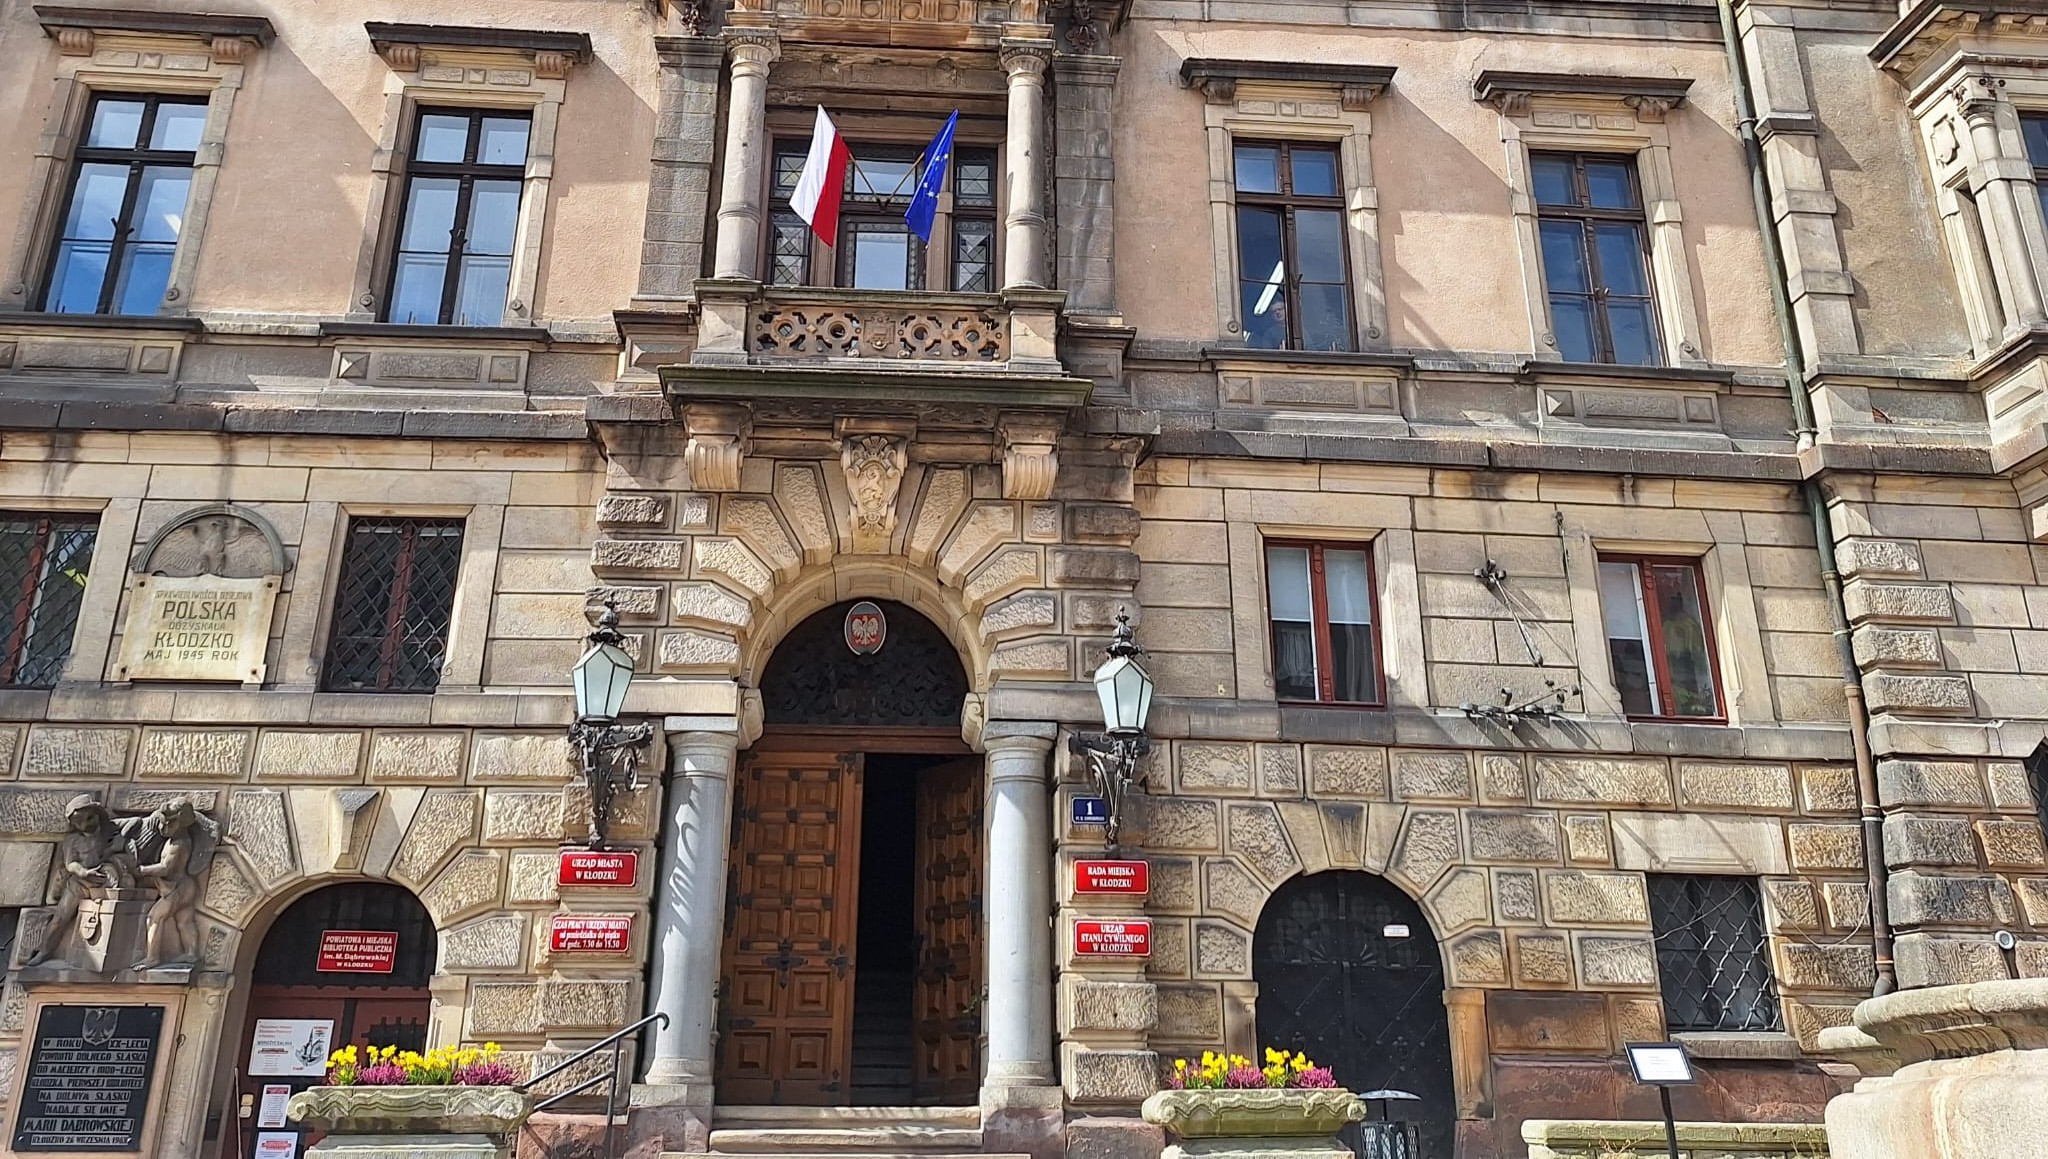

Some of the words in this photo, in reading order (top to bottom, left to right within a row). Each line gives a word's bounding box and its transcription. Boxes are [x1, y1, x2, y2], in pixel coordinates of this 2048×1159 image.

[162, 601, 236, 620] POLSKA
[154, 632, 234, 648] KŁODZKO
[144, 650, 171, 660] MAJ
[178, 650, 204, 660] 1945
[211, 650, 239, 661] ROK
[1086, 800, 1094, 816] 1
[571, 859, 597, 869] URZĄD
[597, 859, 623, 868] MIASTA
[575, 871, 583, 880] W
[583, 871, 618, 880] KŁODZKU
[1087, 866, 1107, 876] RADA
[1107, 867, 1136, 877] MIEJSKA
[1091, 878, 1099, 887] W
[1099, 878, 1133, 888] KŁODZKU
[1100, 924, 1125, 935] URZĄD
[325, 935, 362, 944] POWIATOWA
[366, 936, 393, 945] MIEJSKA
[1080, 933, 1103, 943] STANU
[1103, 934, 1145, 944] CYWILNEGO
[322, 944, 358, 952] BIBLIOTEKA
[358, 944, 393, 953] PUBLICZNA
[1092, 943, 1100, 952] W
[1100, 943, 1134, 953] KŁODZKU
[25, 1119, 58, 1131] MARII
